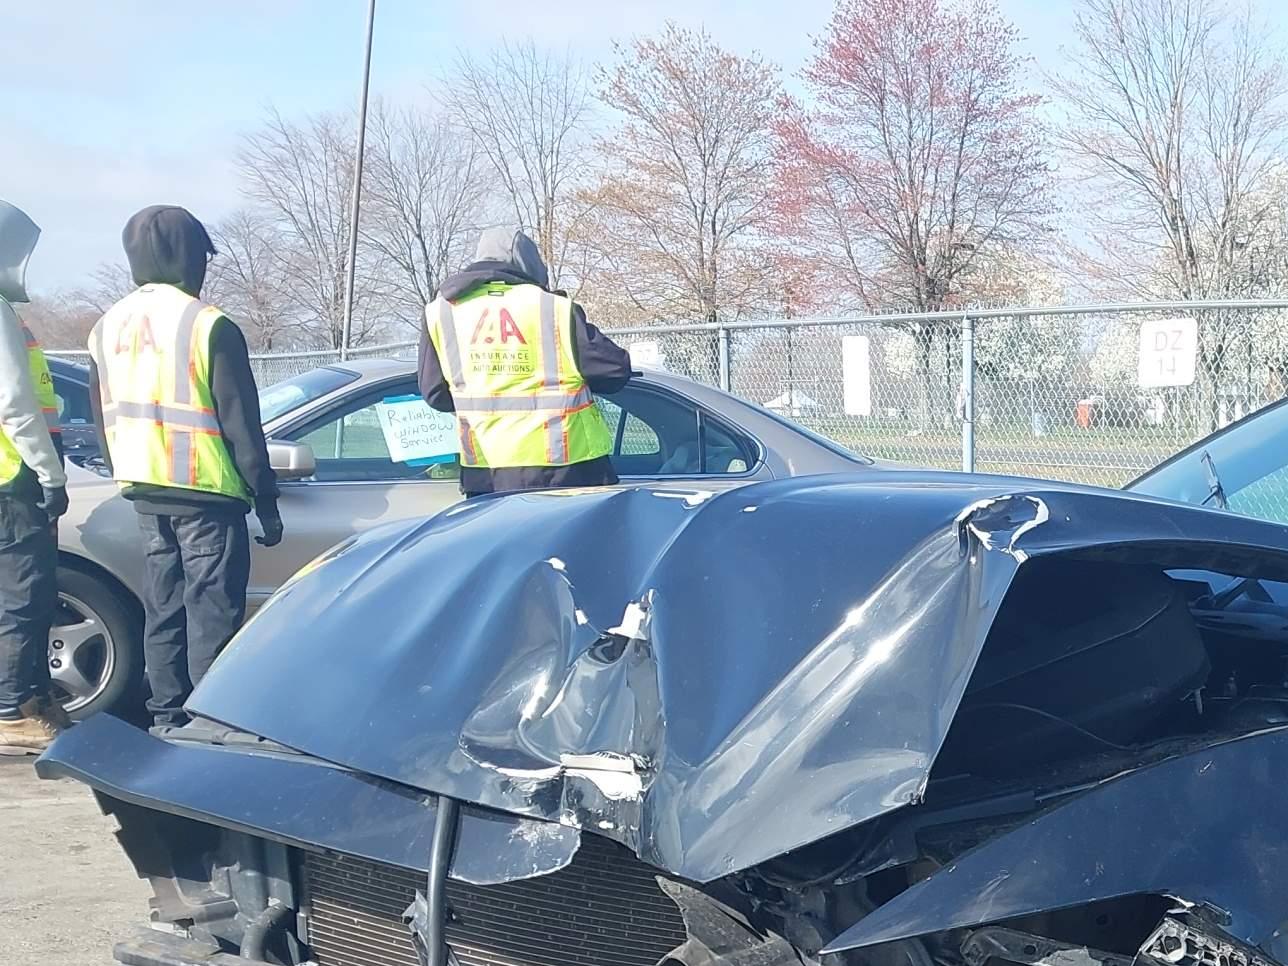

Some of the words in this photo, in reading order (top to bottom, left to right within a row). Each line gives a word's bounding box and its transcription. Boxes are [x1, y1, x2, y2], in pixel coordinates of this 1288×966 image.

[1154, 330, 1183, 351] DZ
[470, 352, 529, 361] INSURANCE
[1158, 355, 1176, 375] 14
